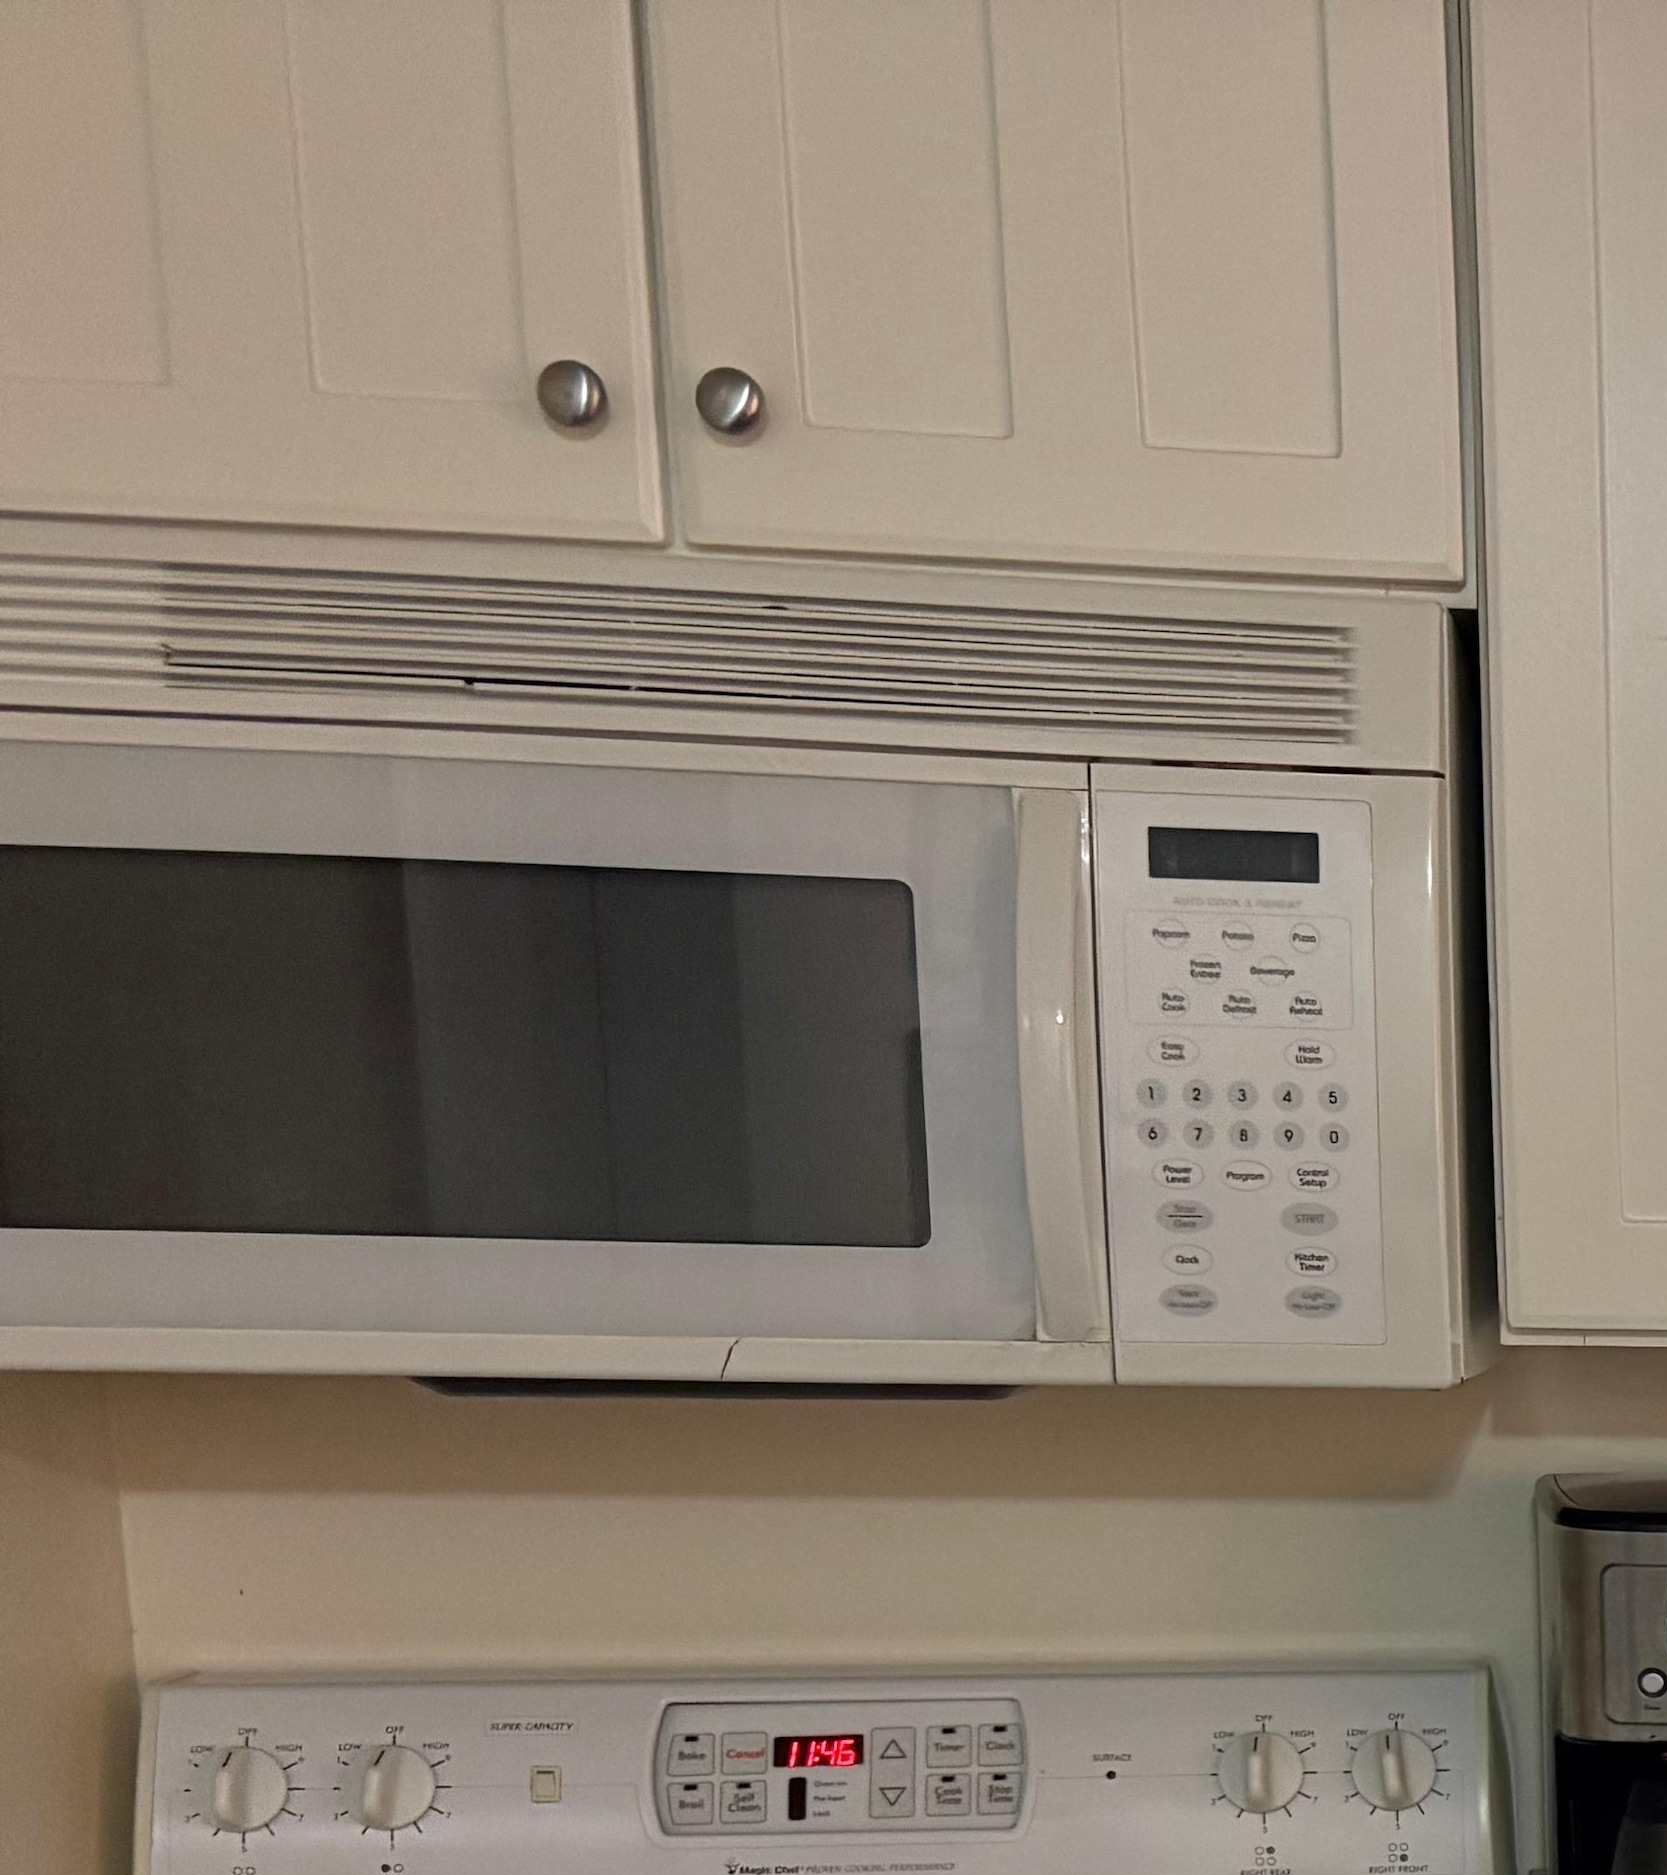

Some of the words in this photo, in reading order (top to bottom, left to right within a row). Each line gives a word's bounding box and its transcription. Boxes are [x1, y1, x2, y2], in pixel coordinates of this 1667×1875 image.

[1250, 966, 1295, 978] Beverage
[1161, 993, 1185, 1001] Auto
[1295, 996, 1317, 1005] Auto
[1161, 1003, 1186, 1011] Cook
[1298, 1045, 1320, 1054] Hold
[1295, 1055, 1323, 1064] Warm
[1149, 1086, 1154, 1100] 1
[1193, 1087, 1201, 1101] 2
[1238, 1089, 1246, 1102] 3
[1282, 1090, 1292, 1103] 4
[1329, 1091, 1338, 1104] 5
[1149, 1127, 1158, 1140] 6
[1194, 1127, 1202, 1141] 7
[1240, 1128, 1248, 1142] 8
[1284, 1129, 1294, 1142] 9
[1330, 1130, 1339, 1143] 0
[1226, 1171, 1265, 1182] Program
[1299, 1178, 1327, 1188] Setup
[1294, 1253, 1329, 1262] Kitchen
[1299, 1262, 1326, 1272] Timer
[725, 1748, 766, 1760] Cancel
[788, 1739, 857, 1769] 11:46
